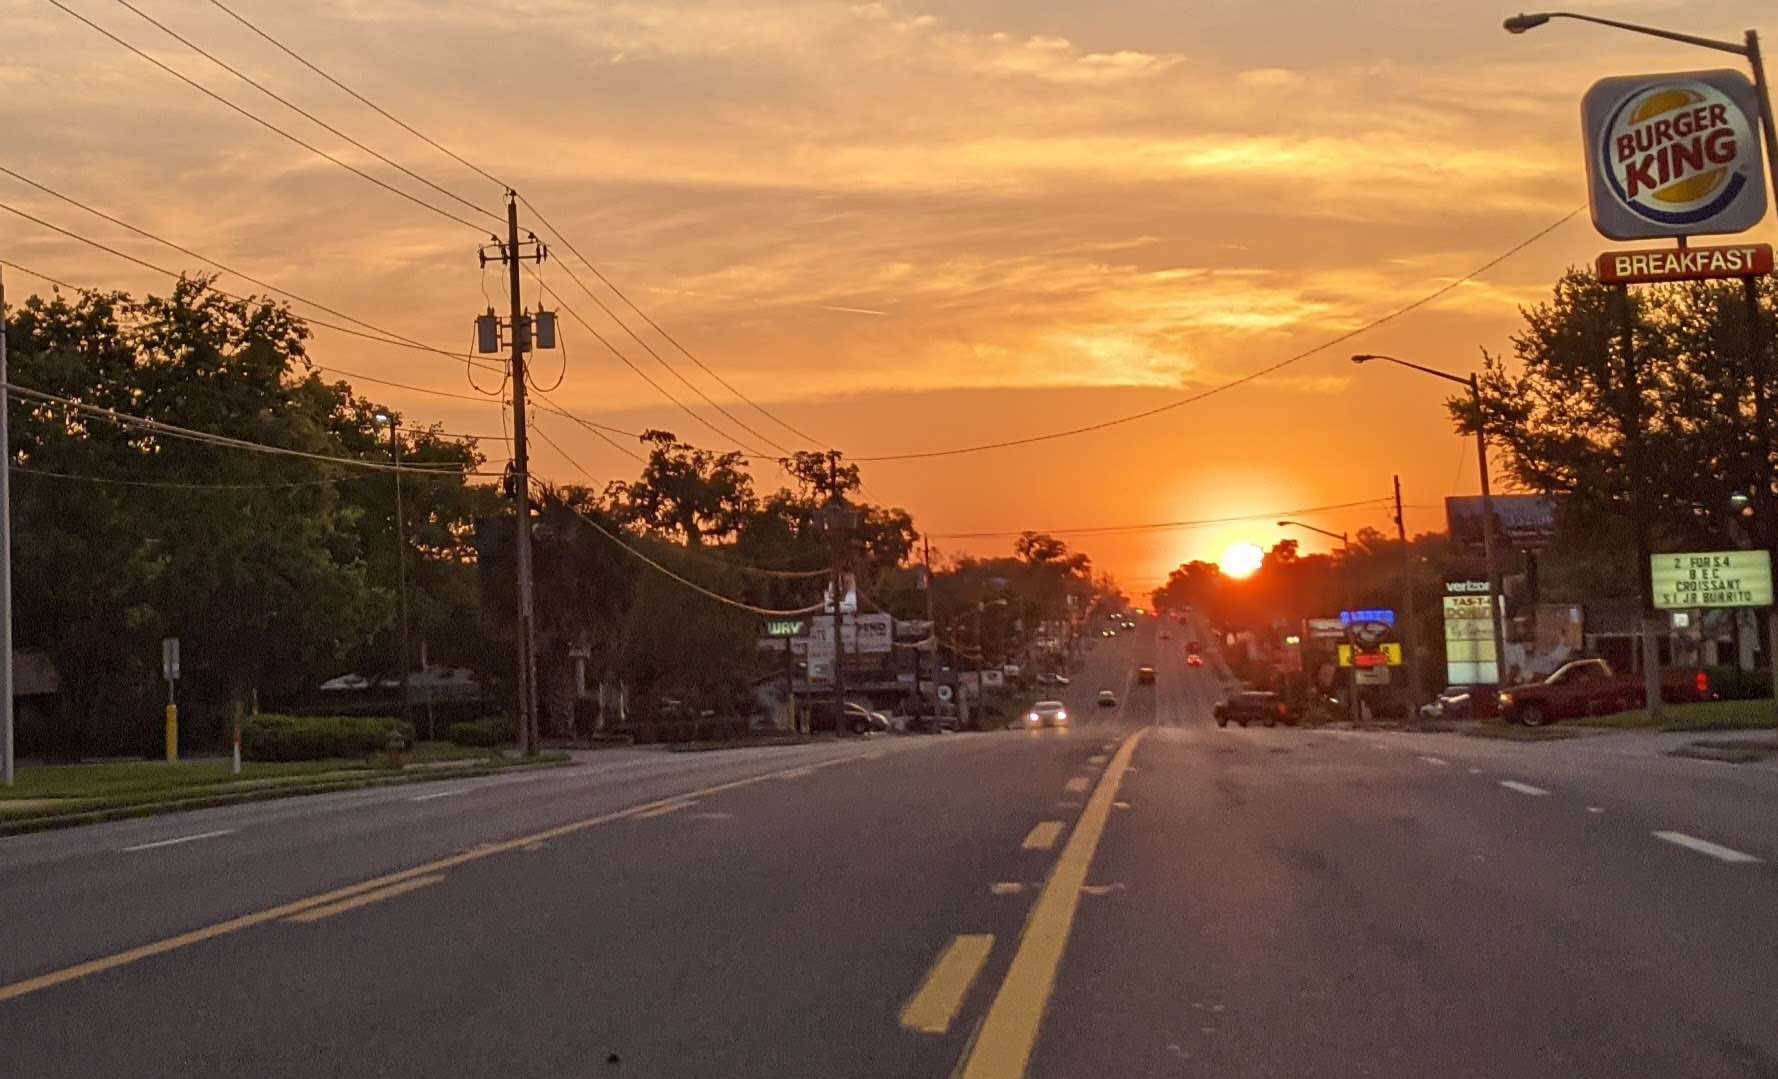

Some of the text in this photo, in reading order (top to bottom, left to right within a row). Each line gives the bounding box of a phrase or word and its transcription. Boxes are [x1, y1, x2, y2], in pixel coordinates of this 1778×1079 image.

[1616, 103, 1728, 163] BURGER
[1625, 128, 1737, 199] KING
[1615, 249, 1756, 277] BREAKFAST
[1674, 558, 1681, 569] 2
[1690, 557, 1710, 568] FOR
[1676, 579, 1740, 592] CROISSANT
[1683, 593, 1697, 604] JR
[1702, 591, 1752, 603] BURRITO
